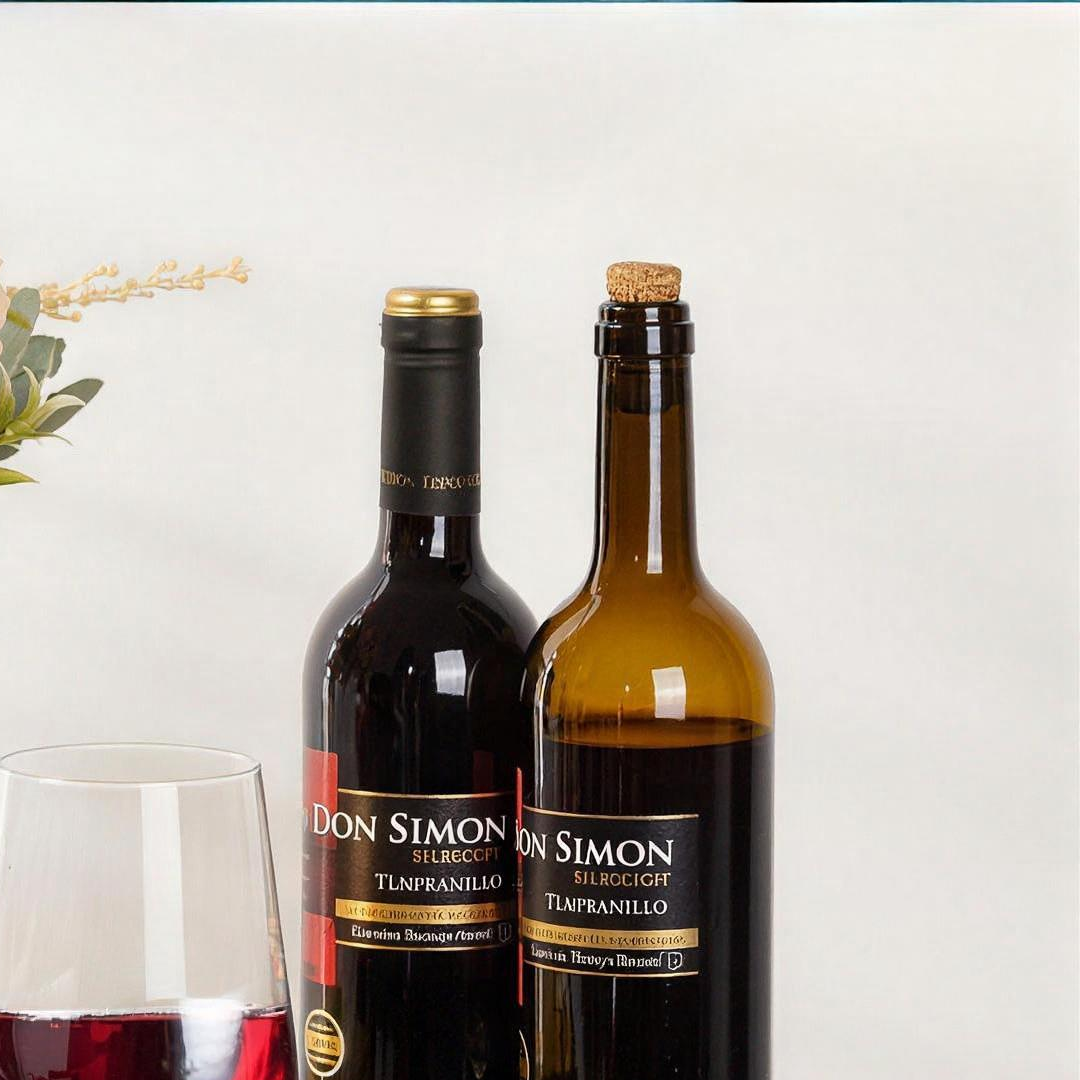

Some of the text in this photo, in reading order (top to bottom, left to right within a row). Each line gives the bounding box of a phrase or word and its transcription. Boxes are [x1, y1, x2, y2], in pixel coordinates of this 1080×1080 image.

[313, 802, 506, 845] DON SIMON
[515, 819, 674, 867] ON SIMON
